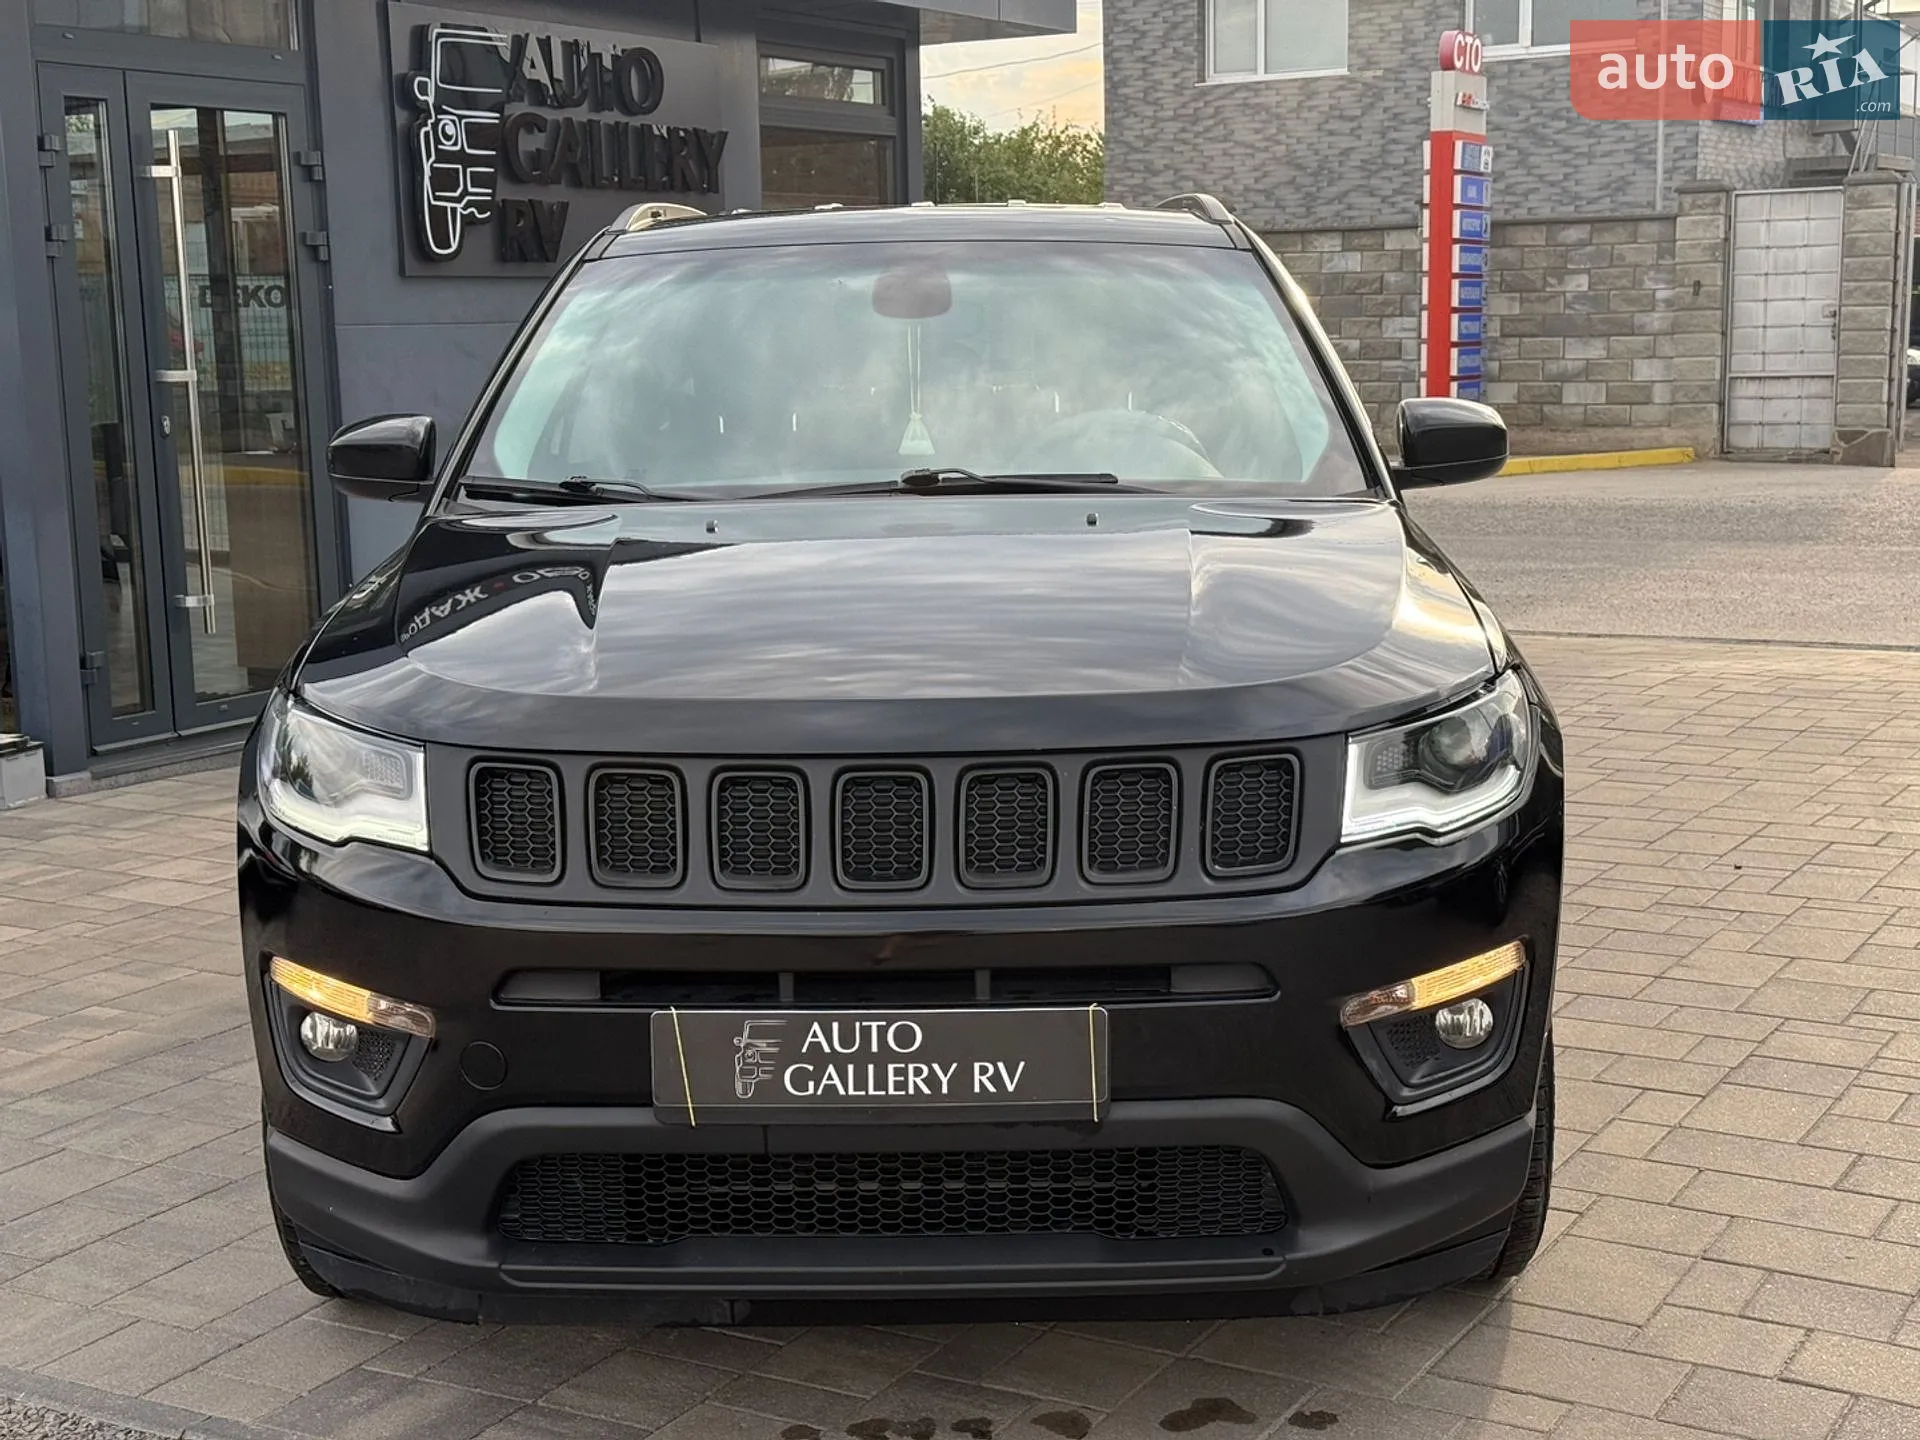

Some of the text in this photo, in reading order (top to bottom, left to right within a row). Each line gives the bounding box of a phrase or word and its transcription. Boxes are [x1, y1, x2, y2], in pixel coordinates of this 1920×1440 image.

[510, 32, 664, 115] AUTO
[1454, 33, 1481, 72] СТО
[503, 112, 728, 193] GALLERY
[499, 198, 569, 262] RV
[801, 1020, 923, 1053] AUTO
[783, 1060, 1026, 1096] GALLERY RV
